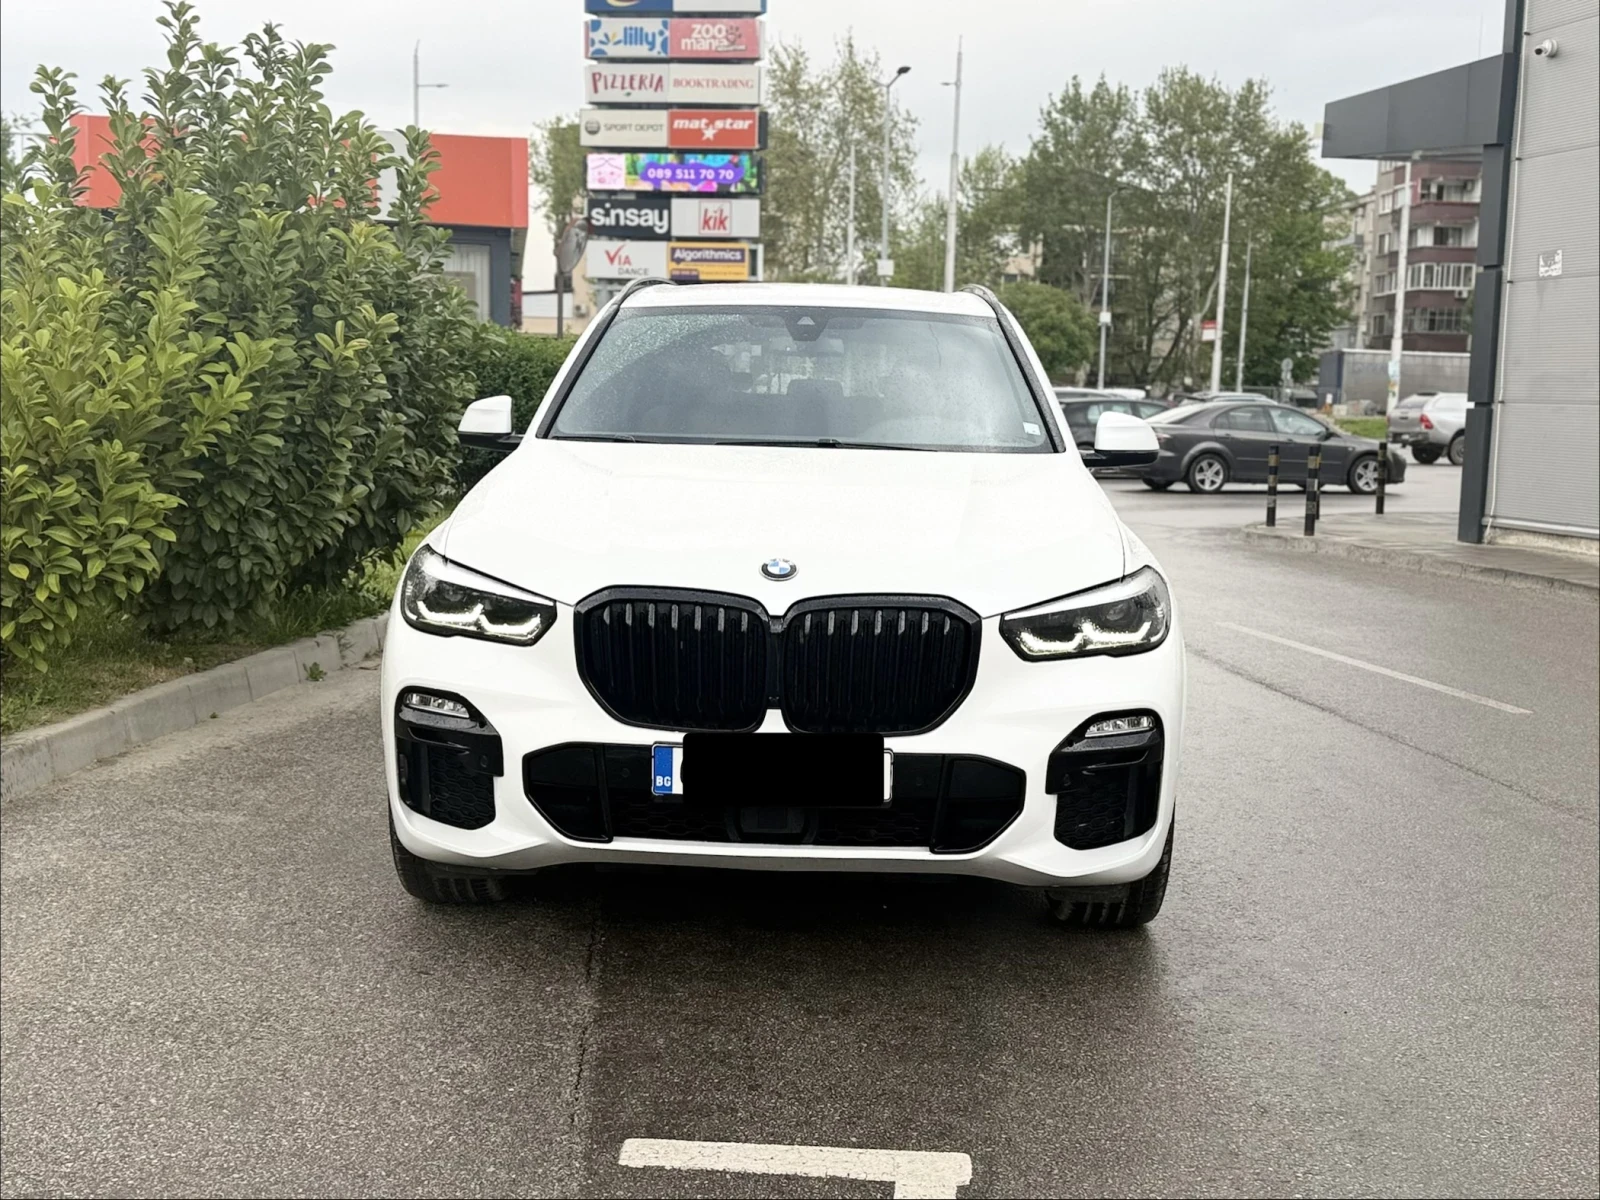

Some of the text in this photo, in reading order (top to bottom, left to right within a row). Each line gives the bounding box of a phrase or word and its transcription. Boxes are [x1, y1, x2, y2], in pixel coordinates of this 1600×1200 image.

[623, 26, 656, 51] lilly
[592, 72, 664, 94] PIZZERIA
[672, 78, 754, 89] BOOKTRADING
[604, 123, 663, 132] SPORT DEPOT
[647, 168, 734, 180] 089 511 70 70
[591, 203, 669, 234] sinsay
[702, 206, 728, 231] kik
[605, 245, 632, 266] VIA
[674, 248, 742, 261] Algorithmics
[618, 267, 649, 276] DANCE
[656, 775, 671, 787] BG
